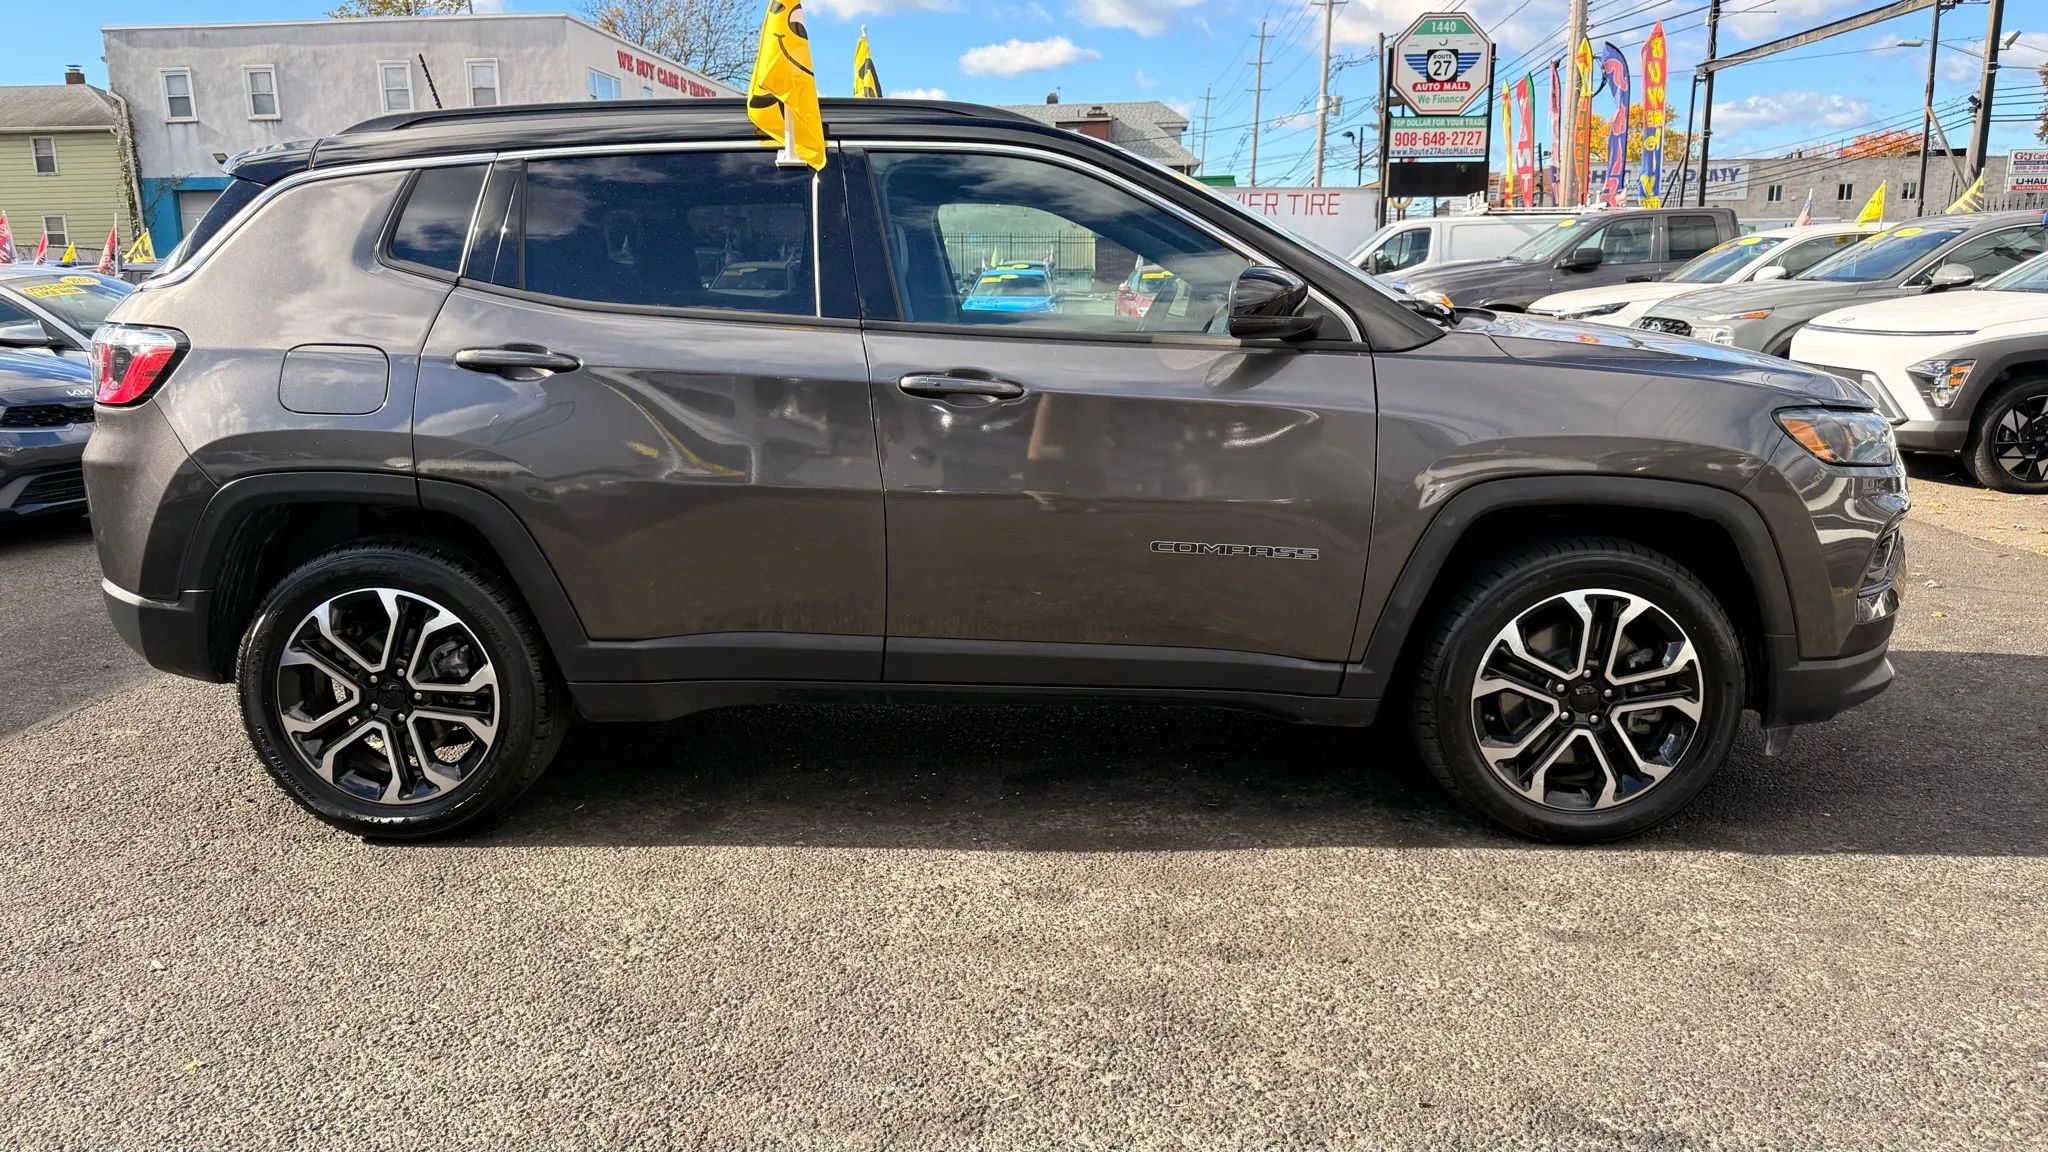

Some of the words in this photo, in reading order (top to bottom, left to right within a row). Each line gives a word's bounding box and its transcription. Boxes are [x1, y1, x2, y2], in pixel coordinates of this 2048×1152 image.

[1431, 21, 1456, 33] 1440
[616, 49, 634, 73] WE
[635, 58, 656, 81] BUY
[656, 67, 679, 90] CARS
[1432, 60, 1452, 76] 27
[1415, 83, 1441, 91] AUTO
[1442, 82, 1468, 90] MALL
[1417, 94, 1430, 104] We
[1432, 94, 1465, 104] Finance
[1393, 119, 1406, 127] TOP
[1406, 119, 1431, 127] DOLLAR
[1446, 118, 1464, 126] YOUR
[1465, 118, 1487, 126] TRADE
[1394, 131, 1482, 147] 908-648-2727
[1390, 147, 1485, 156] www.Route27AutoMall.com
[1287, 193, 1341, 216] TIRE
[1150, 540, 1320, 561] COMPASS
